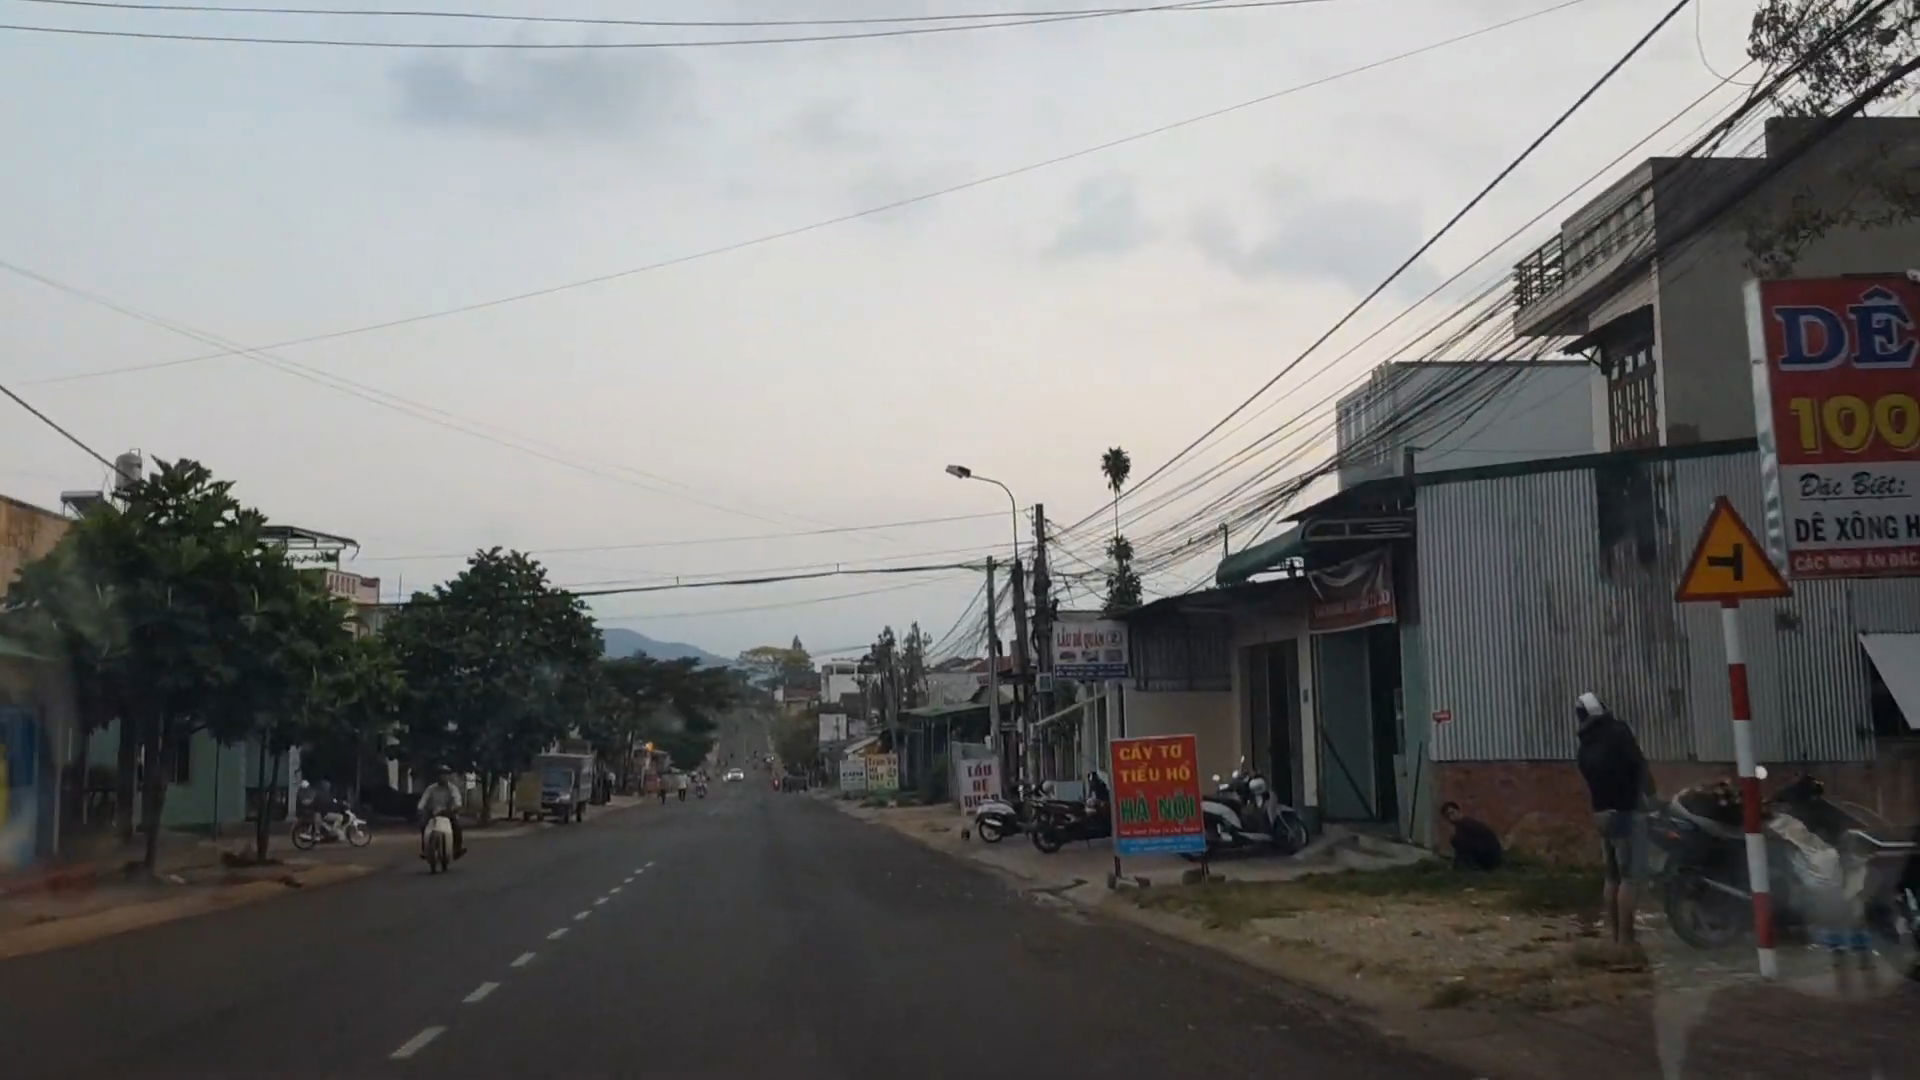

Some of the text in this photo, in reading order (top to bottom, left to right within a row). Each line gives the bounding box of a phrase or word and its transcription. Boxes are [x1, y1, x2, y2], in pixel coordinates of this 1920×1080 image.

[1772, 285, 1920, 371] DÊ
[1790, 393, 1920, 454] 100
[1795, 511, 1826, 542] DÊ
[1835, 510, 1899, 542] XÔNG
[1119, 789, 1197, 825] HÀ NỘI
